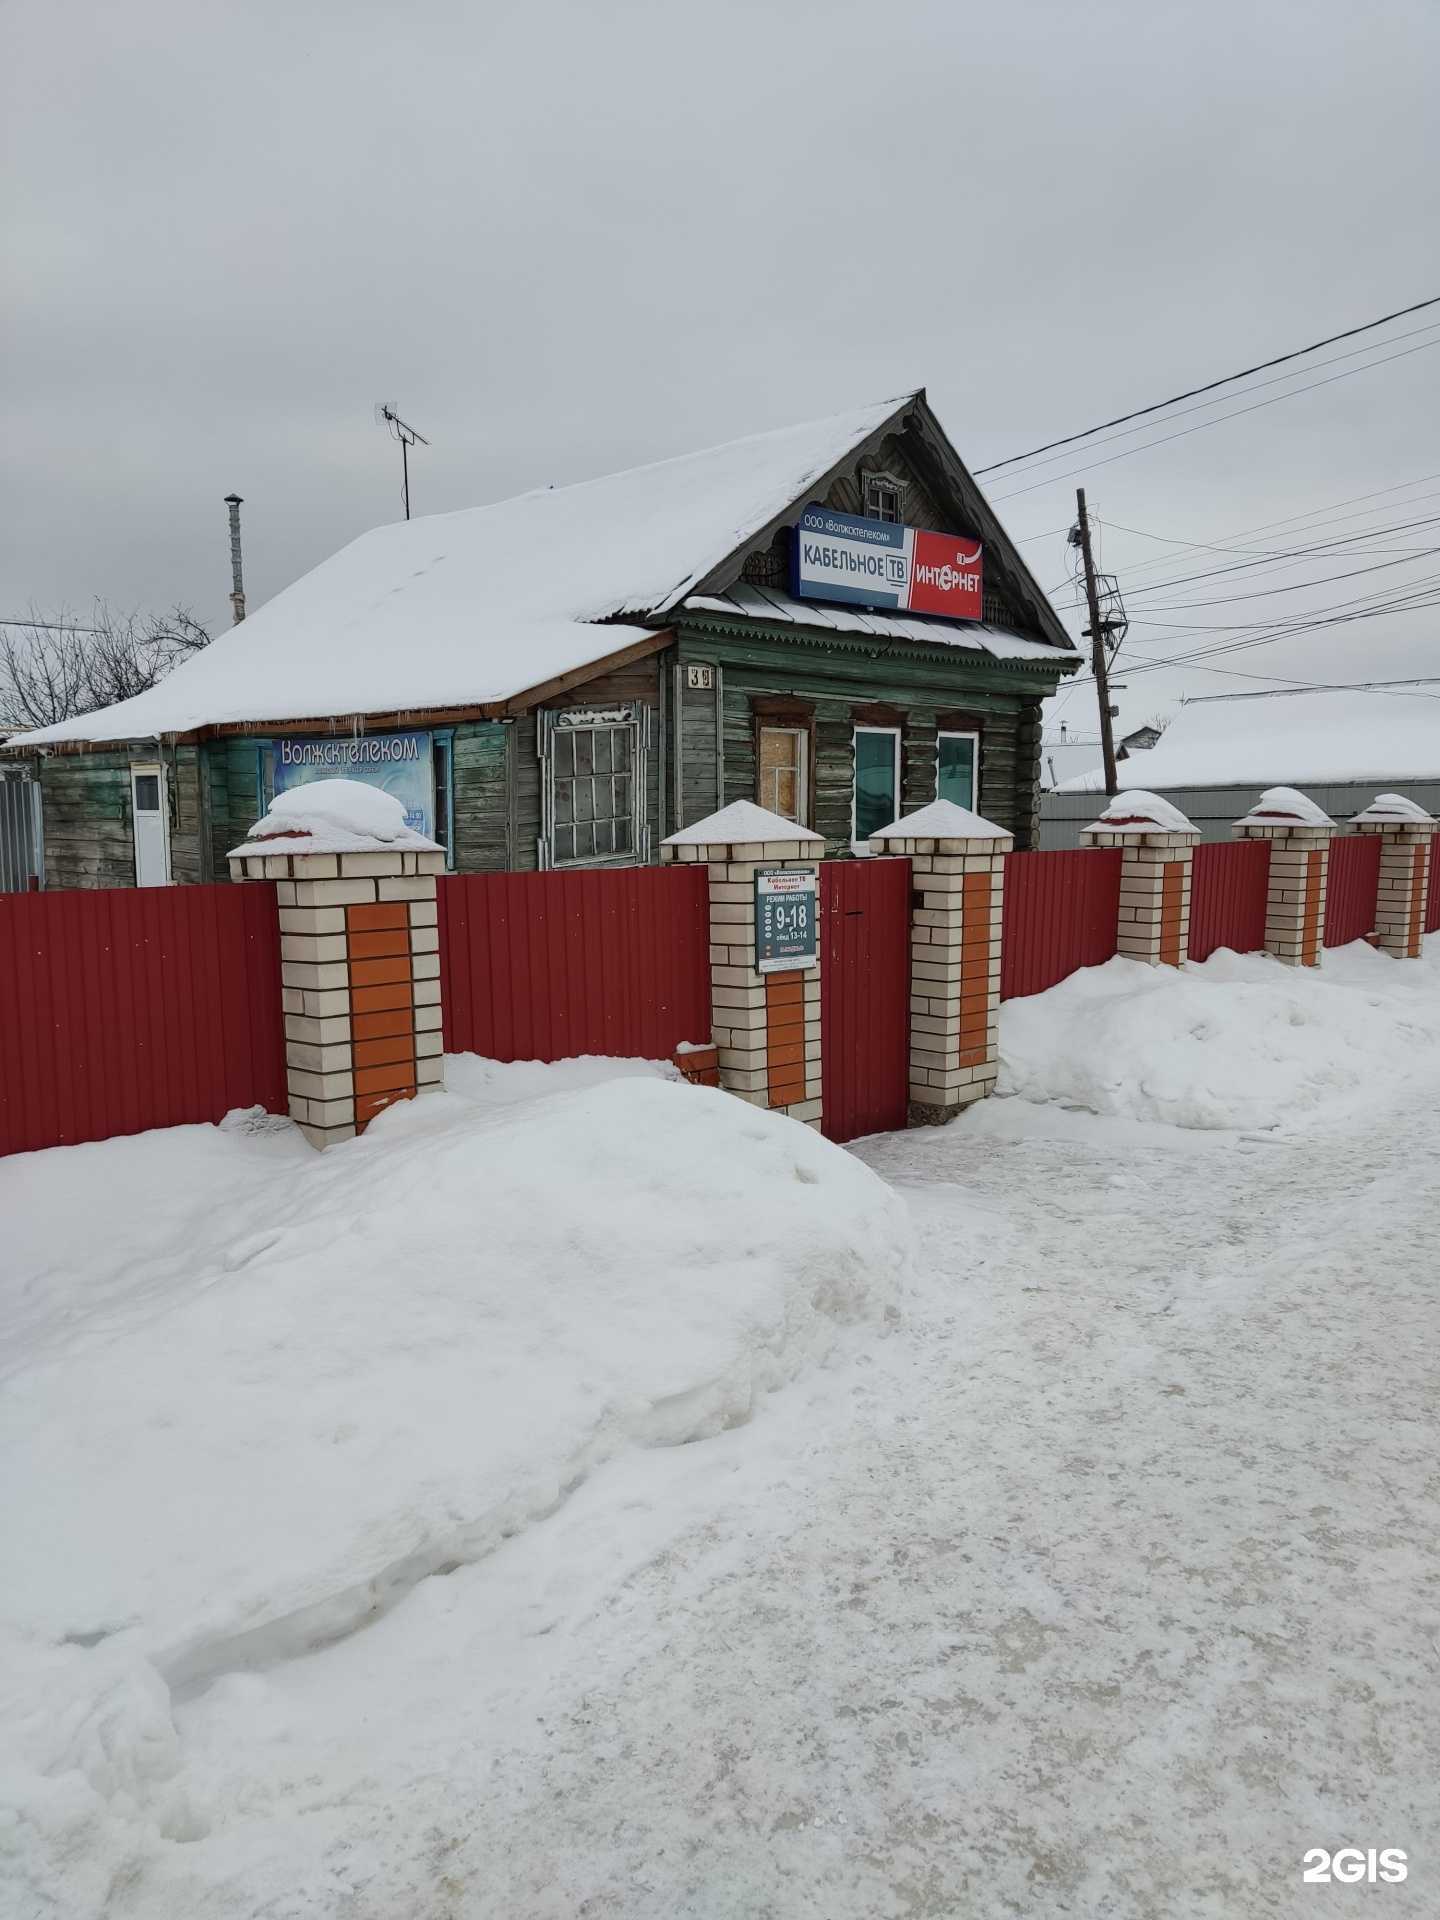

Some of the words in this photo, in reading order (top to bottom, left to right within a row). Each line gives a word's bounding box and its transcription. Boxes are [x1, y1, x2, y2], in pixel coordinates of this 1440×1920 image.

[804, 514, 824, 529] ООО
[804, 544, 884, 577] КАБЕЛЬНОЕ
[890, 560, 905, 579] ТВ
[766, 895, 785, 903] РЕЖИМ
[785, 894, 808, 902] РАБОТЫ
[776, 904, 807, 929] 9-18
[790, 931, 807, 940] 13-14
